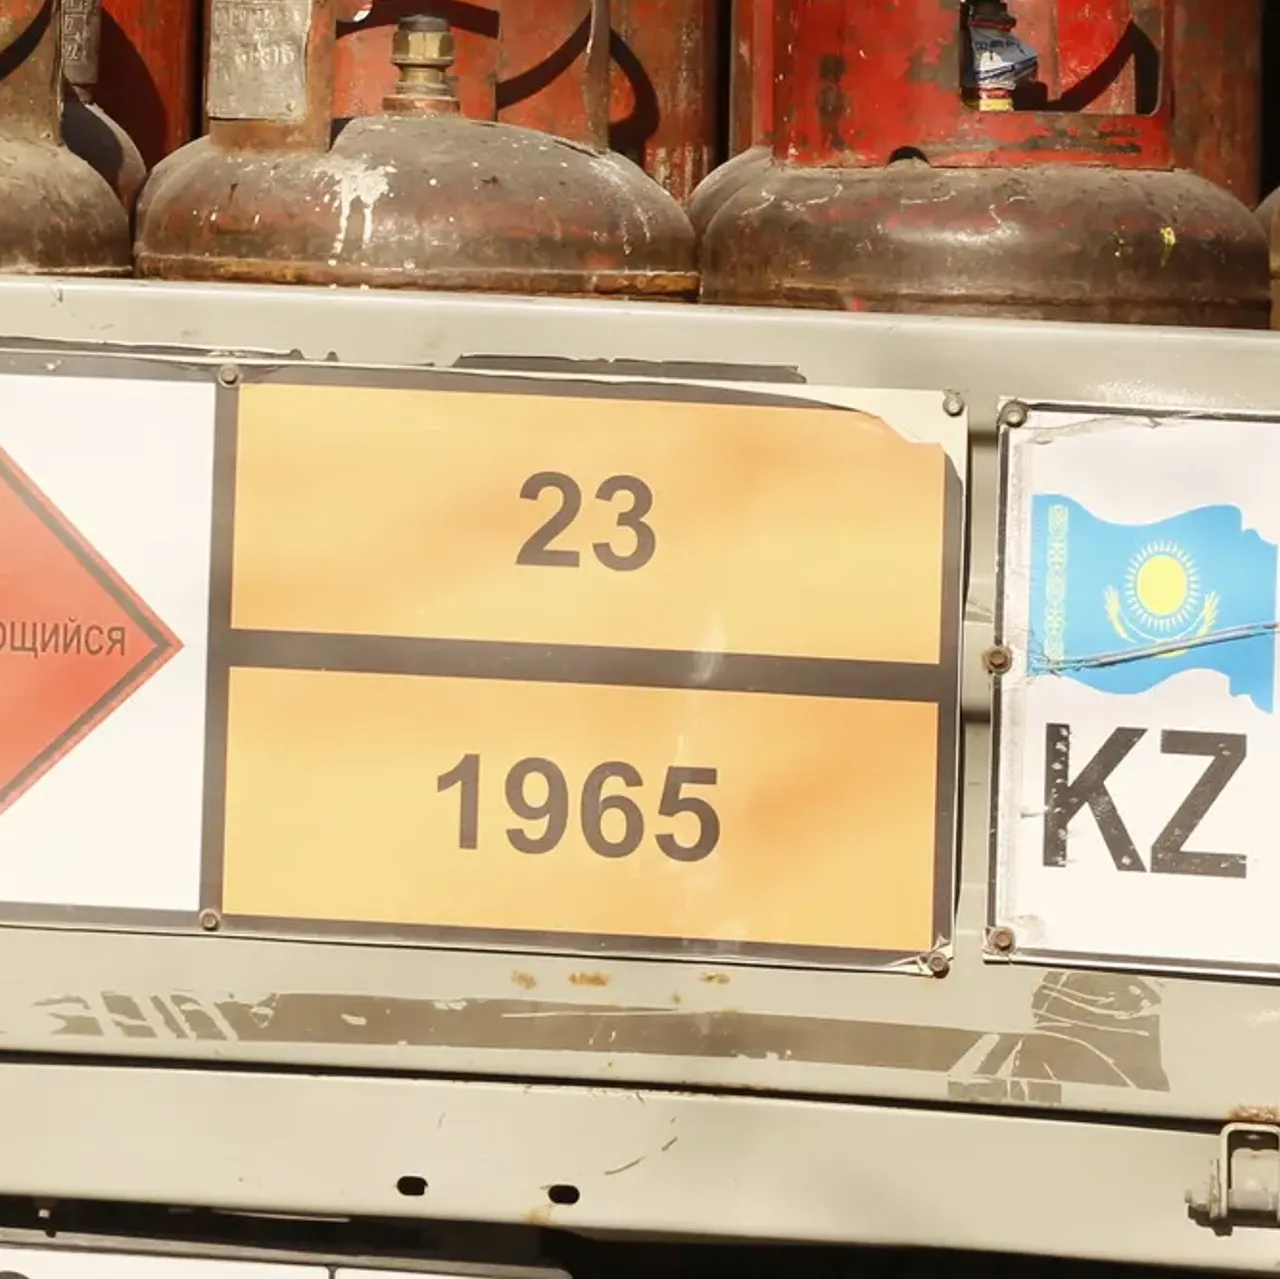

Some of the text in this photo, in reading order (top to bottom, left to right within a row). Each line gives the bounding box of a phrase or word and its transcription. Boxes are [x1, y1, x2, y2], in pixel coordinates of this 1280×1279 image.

[515, 471, 657, 572] 23
[436, 753, 721, 863] 1965
[1042, 722, 1248, 879] KZ
